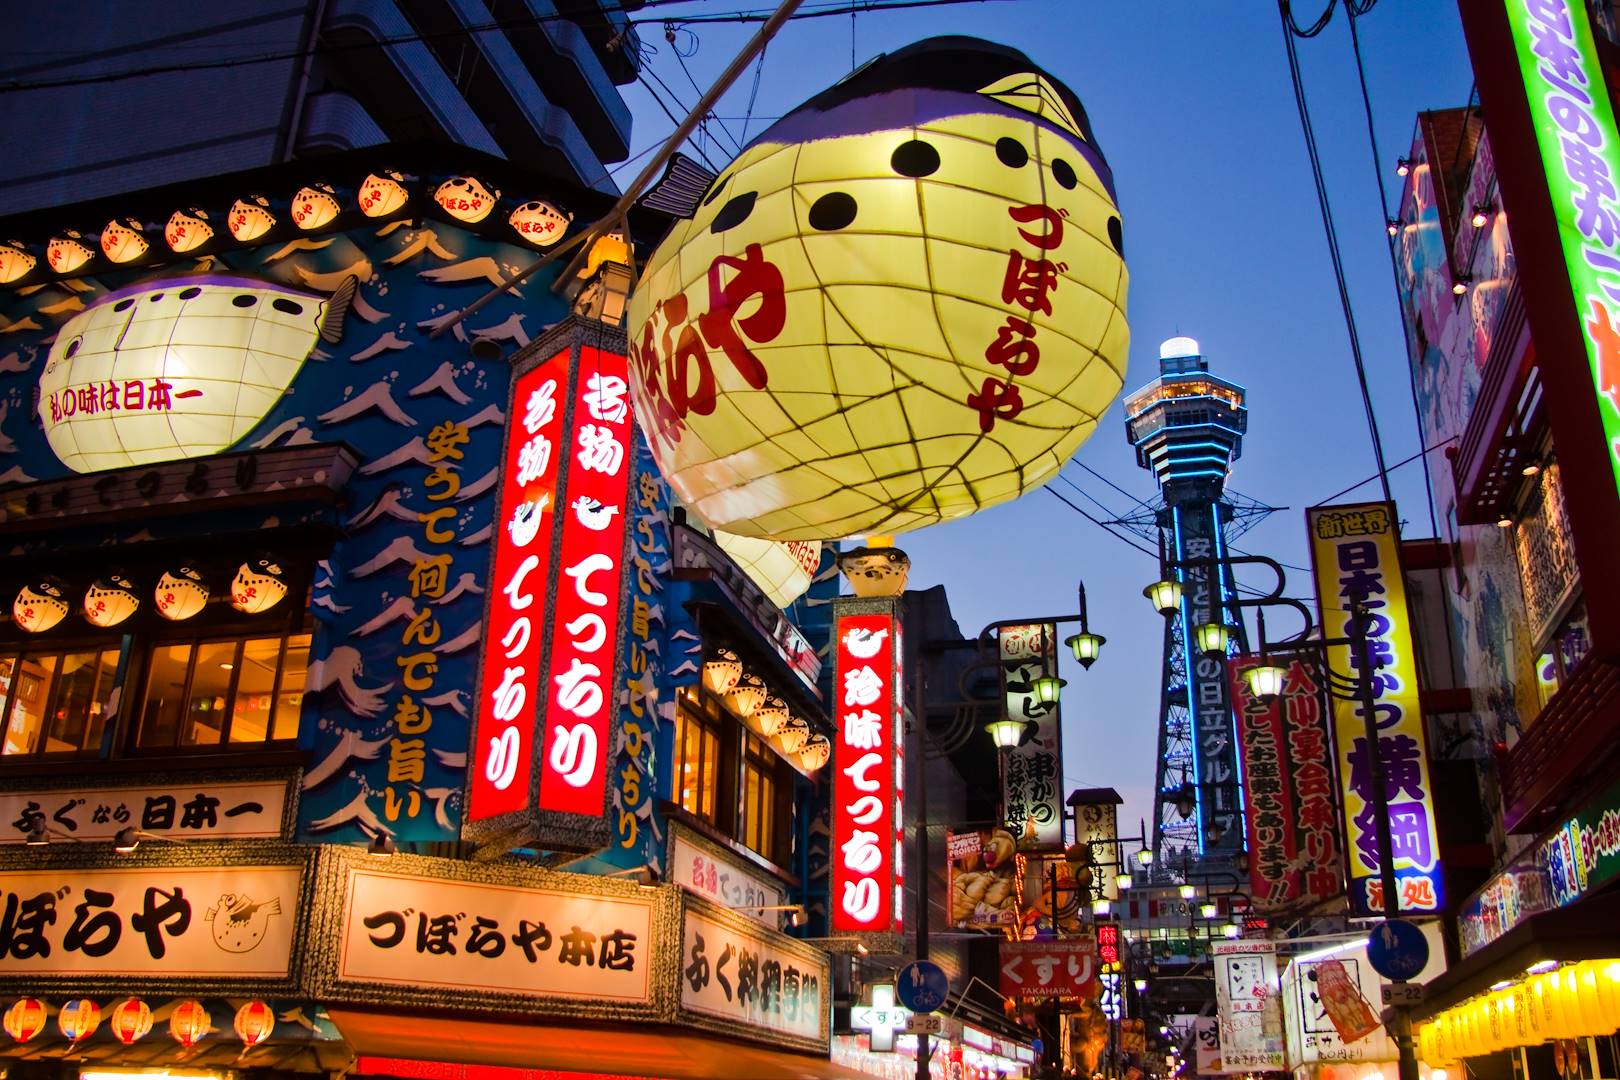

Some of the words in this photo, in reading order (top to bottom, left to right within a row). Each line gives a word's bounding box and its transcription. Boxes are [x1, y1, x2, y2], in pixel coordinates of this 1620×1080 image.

[967, 203, 1070, 433] づぼらや
[1318, 510, 1390, 538] 新世界
[384, 420, 469, 821] 安うて何んでも旨い
[1185, 538, 1233, 836] 安心と信の日立グループ
[12, 793, 264, 832] ふぐなら日本一
[0, 885, 192, 960] ぼらや
[363, 908, 638, 972] づぼらや本店
[1002, 955, 1091, 985] くすり
[859, 1009, 905, 1025] くすり
